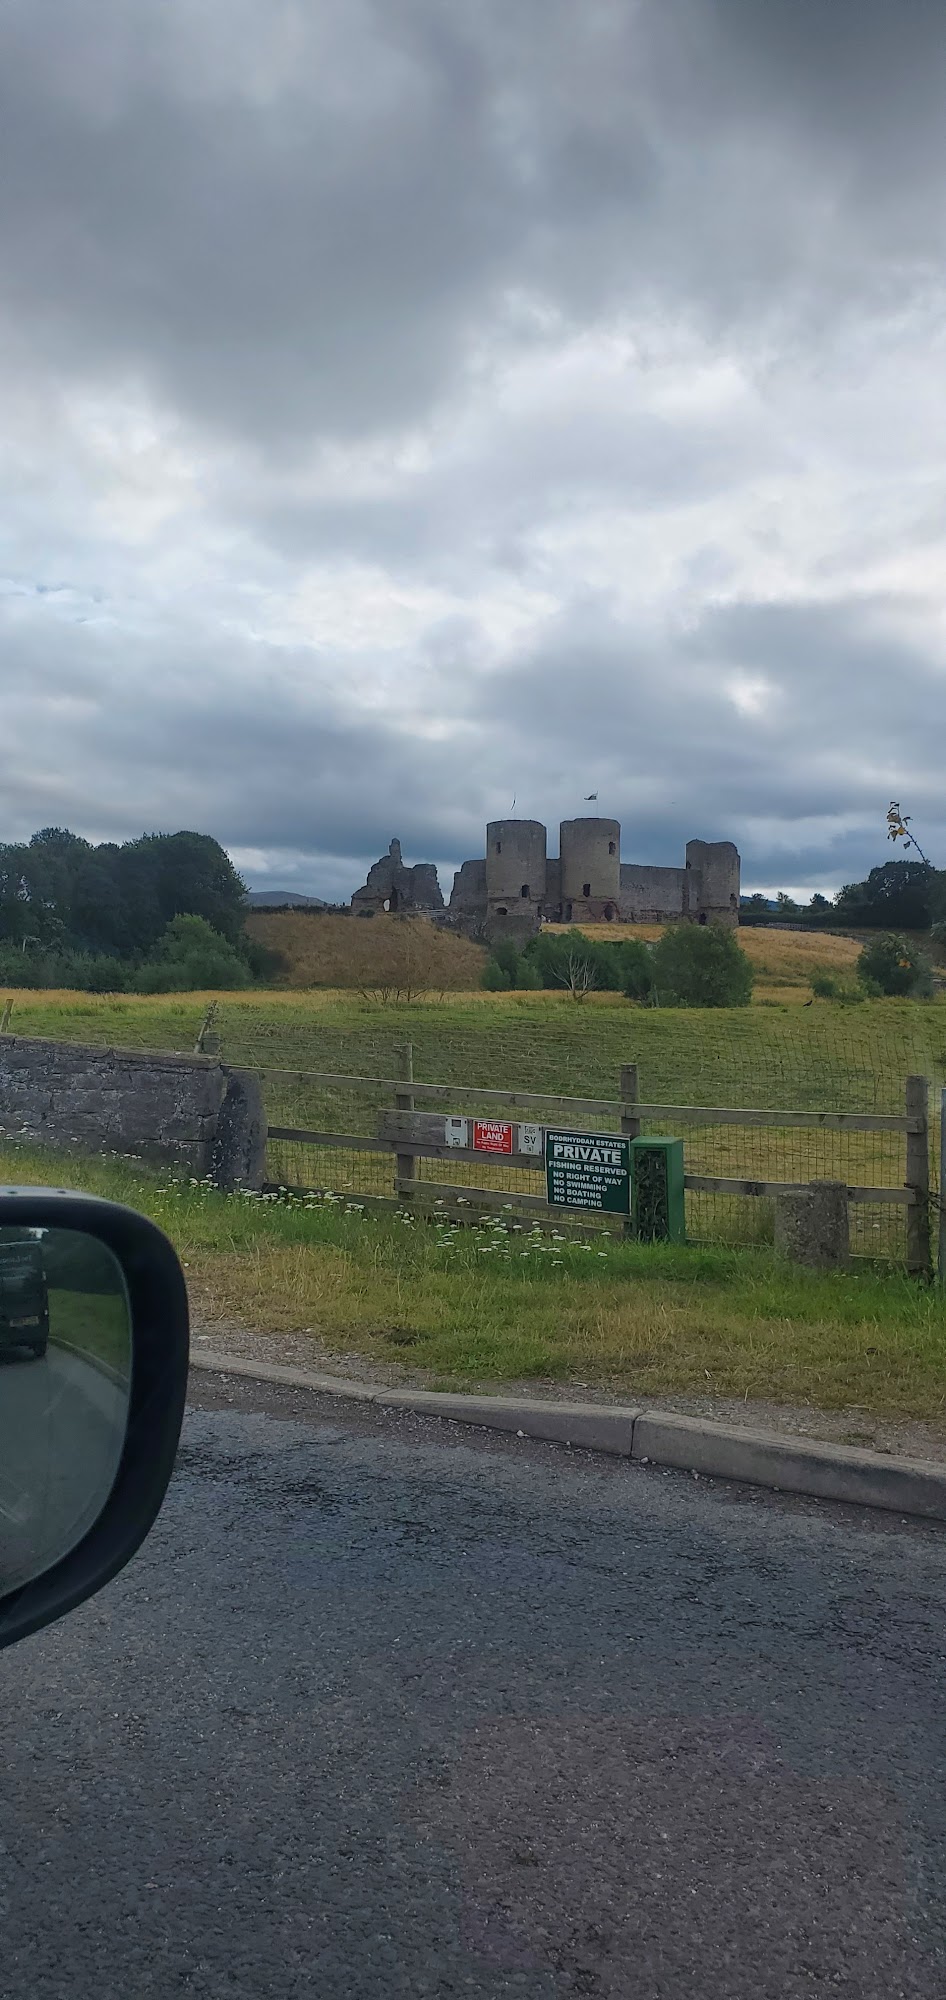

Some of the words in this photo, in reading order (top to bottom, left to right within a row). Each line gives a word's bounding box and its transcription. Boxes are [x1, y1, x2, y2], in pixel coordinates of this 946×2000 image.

[477, 1123, 509, 1134] PRIVATE
[481, 1131, 504, 1141] LAND
[524, 1135, 537, 1145] SV
[549, 1135, 594, 1146] BODRHYDDAN
[596, 1139, 626, 1149] ESTATES
[553, 1144, 621, 1164] PRIVATE
[548, 1160, 582, 1171] FISHING
[583, 1164, 627, 1176] RESERVED
[553, 1171, 565, 1179] NO
[566, 1172, 590, 1182] RIGHT
[592, 1175, 603, 1183] OF
[604, 1177, 622, 1186] WAY
[553, 1179, 565, 1187] NO
[566, 1180, 608, 1192] SWIMMING
[553, 1187, 565, 1195] NO
[566, 1188, 602, 1199] BOATING
[554, 1195, 565, 1203] NO
[566, 1197, 603, 1208] CAMPING
